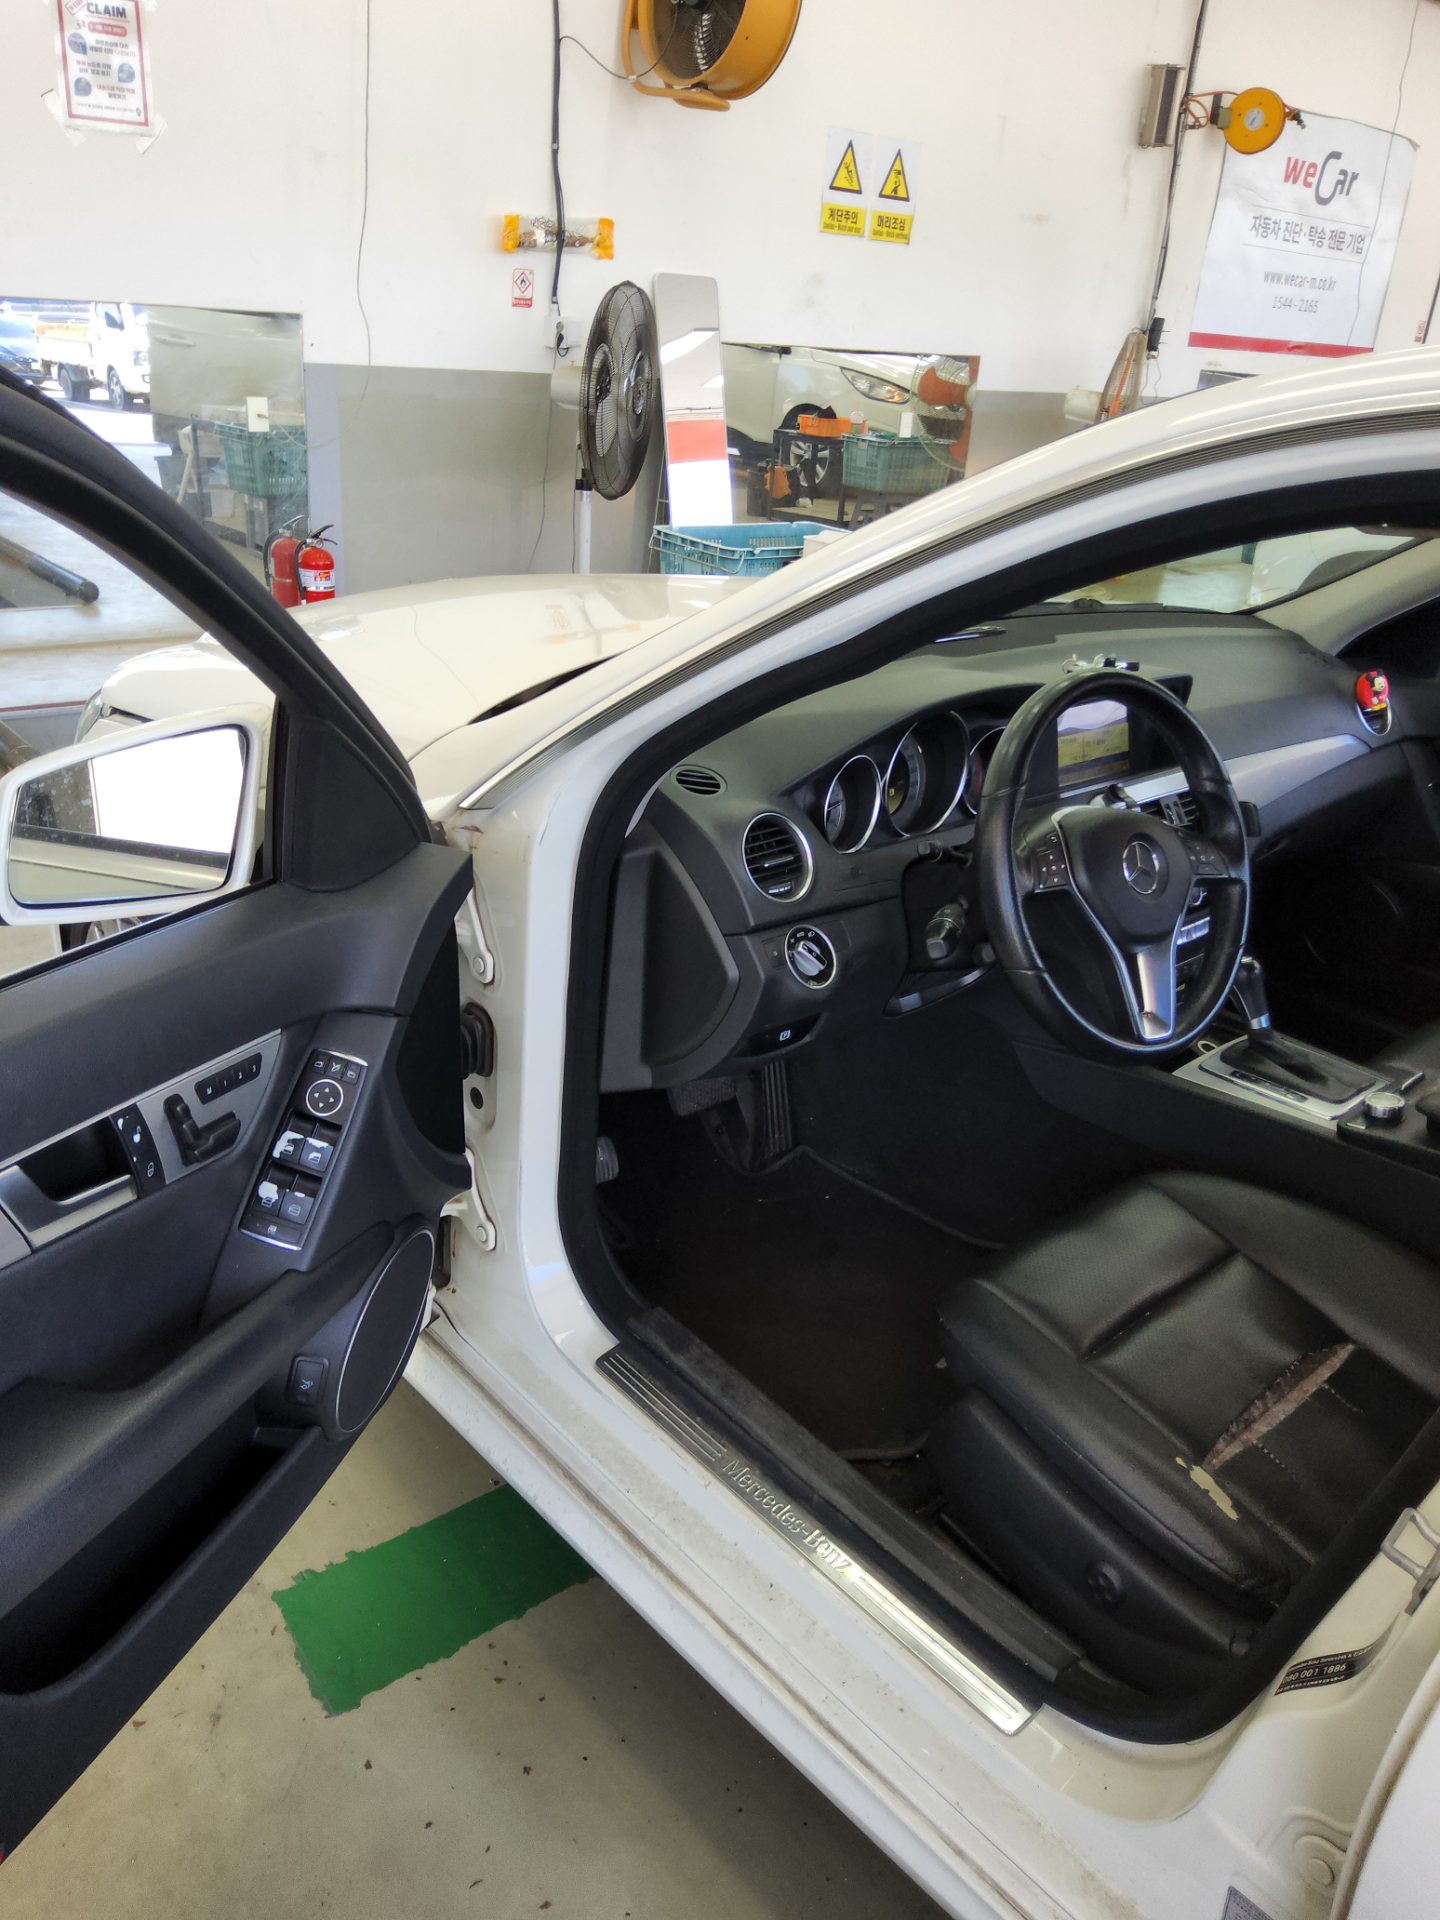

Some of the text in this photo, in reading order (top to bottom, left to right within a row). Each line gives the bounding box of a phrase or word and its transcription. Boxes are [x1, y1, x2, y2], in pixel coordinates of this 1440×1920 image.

[86, 2, 127, 18] CLAIM
[828, 207, 858, 225] 계단주의
[877, 215, 906, 231] 머리조심
[1250, 215, 1282, 240] 자동차
[1328, 229, 1346, 251] 전문
[1347, 232, 1365, 254] 기업
[1264, 271, 1336, 291] www.wecar-m.co.kr
[722, 1460, 852, 1573] Mercedes-Benz
[1300, 1668, 1319, 1678] 001
[1323, 1662, 1347, 1674] 1886
